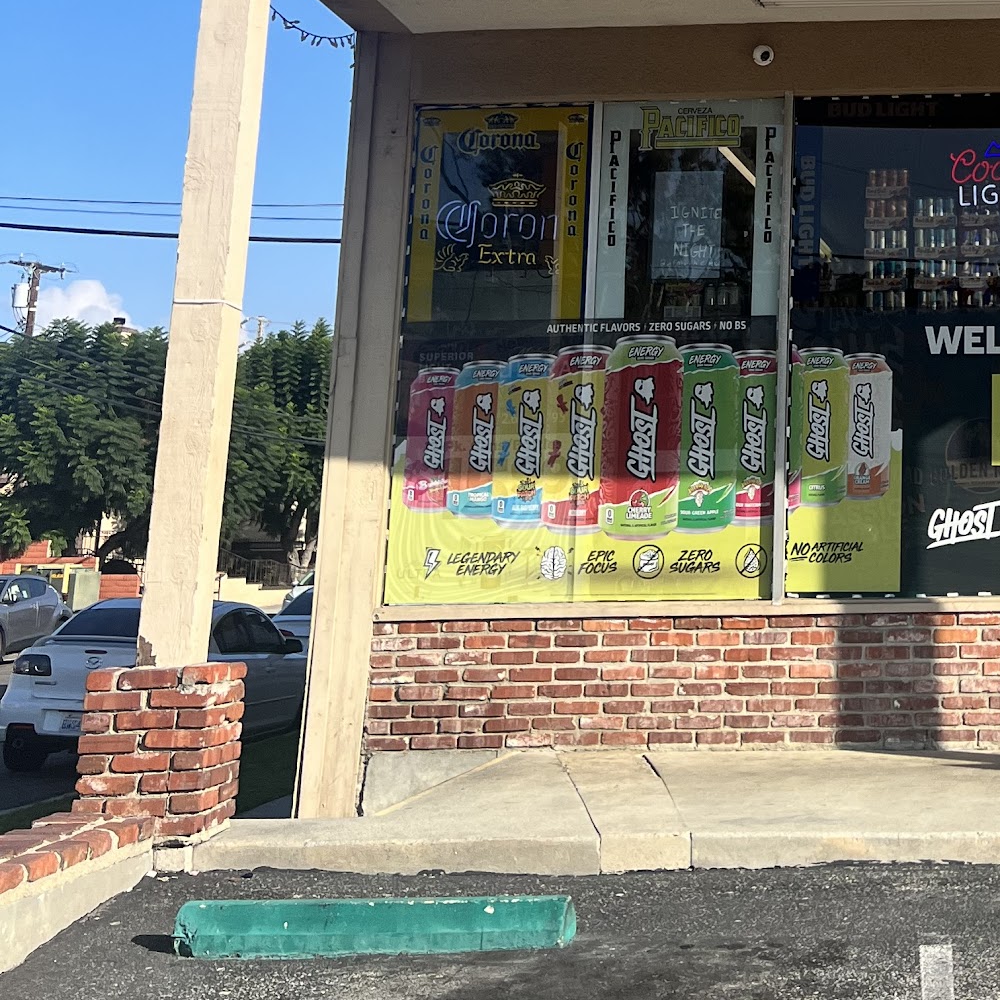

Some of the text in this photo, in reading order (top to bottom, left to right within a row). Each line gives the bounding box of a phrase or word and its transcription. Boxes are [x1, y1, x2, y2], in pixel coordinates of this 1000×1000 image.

[678, 107, 713, 115] CERVEZA
[827, 101, 939, 117] BUD LIGHT
[457, 128, 541, 156] Corona
[420, 145, 439, 240] Corona
[566, 142, 584, 237] Corona
[607, 130, 622, 247] PACIFICO
[763, 126, 777, 244] PACIFICO
[670, 206, 722, 219] IGNITE
[798, 155, 816, 264] BUD LIGHT
[437, 200, 558, 248] Coron
[682, 223, 706, 238] THE
[478, 244, 536, 265] Extra
[673, 241, 716, 258] NIGHT
[547, 320, 747, 333] AUTHENTIC FLAVORS ZERO SUGARS NO BS
[420, 352, 474, 361] SUPERIOR
[629, 346, 664, 357] ENERGY
[570, 356, 602, 367] ENERGY
[688, 354, 721, 365] ENERGY
[741, 359, 771, 369] ENERGY
[806, 356, 834, 367] ENERGY
[851, 360, 877, 370] ENERGY
[473, 370, 500, 378] ENERGY
[519, 363, 550, 374] ENERGY
[806, 391, 831, 462] GHOST
[851, 394, 876, 459] GHOST
[423, 410, 447, 470] GHOST
[469, 405, 495, 473] GHOST
[515, 403, 543, 477] GHOST
[567, 398, 597, 480] GHOST
[626, 395, 658, 482] GHOST
[687, 398, 717, 480] GHOST
[740, 399, 768, 474] GHOST
[625, 512, 652, 520] LIMEADE
[587, 550, 615, 562] EPIC
[677, 550, 713, 562] ZERO
[790, 541, 864, 557] NO ARTIFICIAL
[447, 551, 520, 564] LEGENDARY
[809, 552, 852, 563] COLORS
[456, 563, 507, 576] ENERGY
[578, 562, 618, 575] FOCUS
[669, 561, 721, 573] SUGARS
